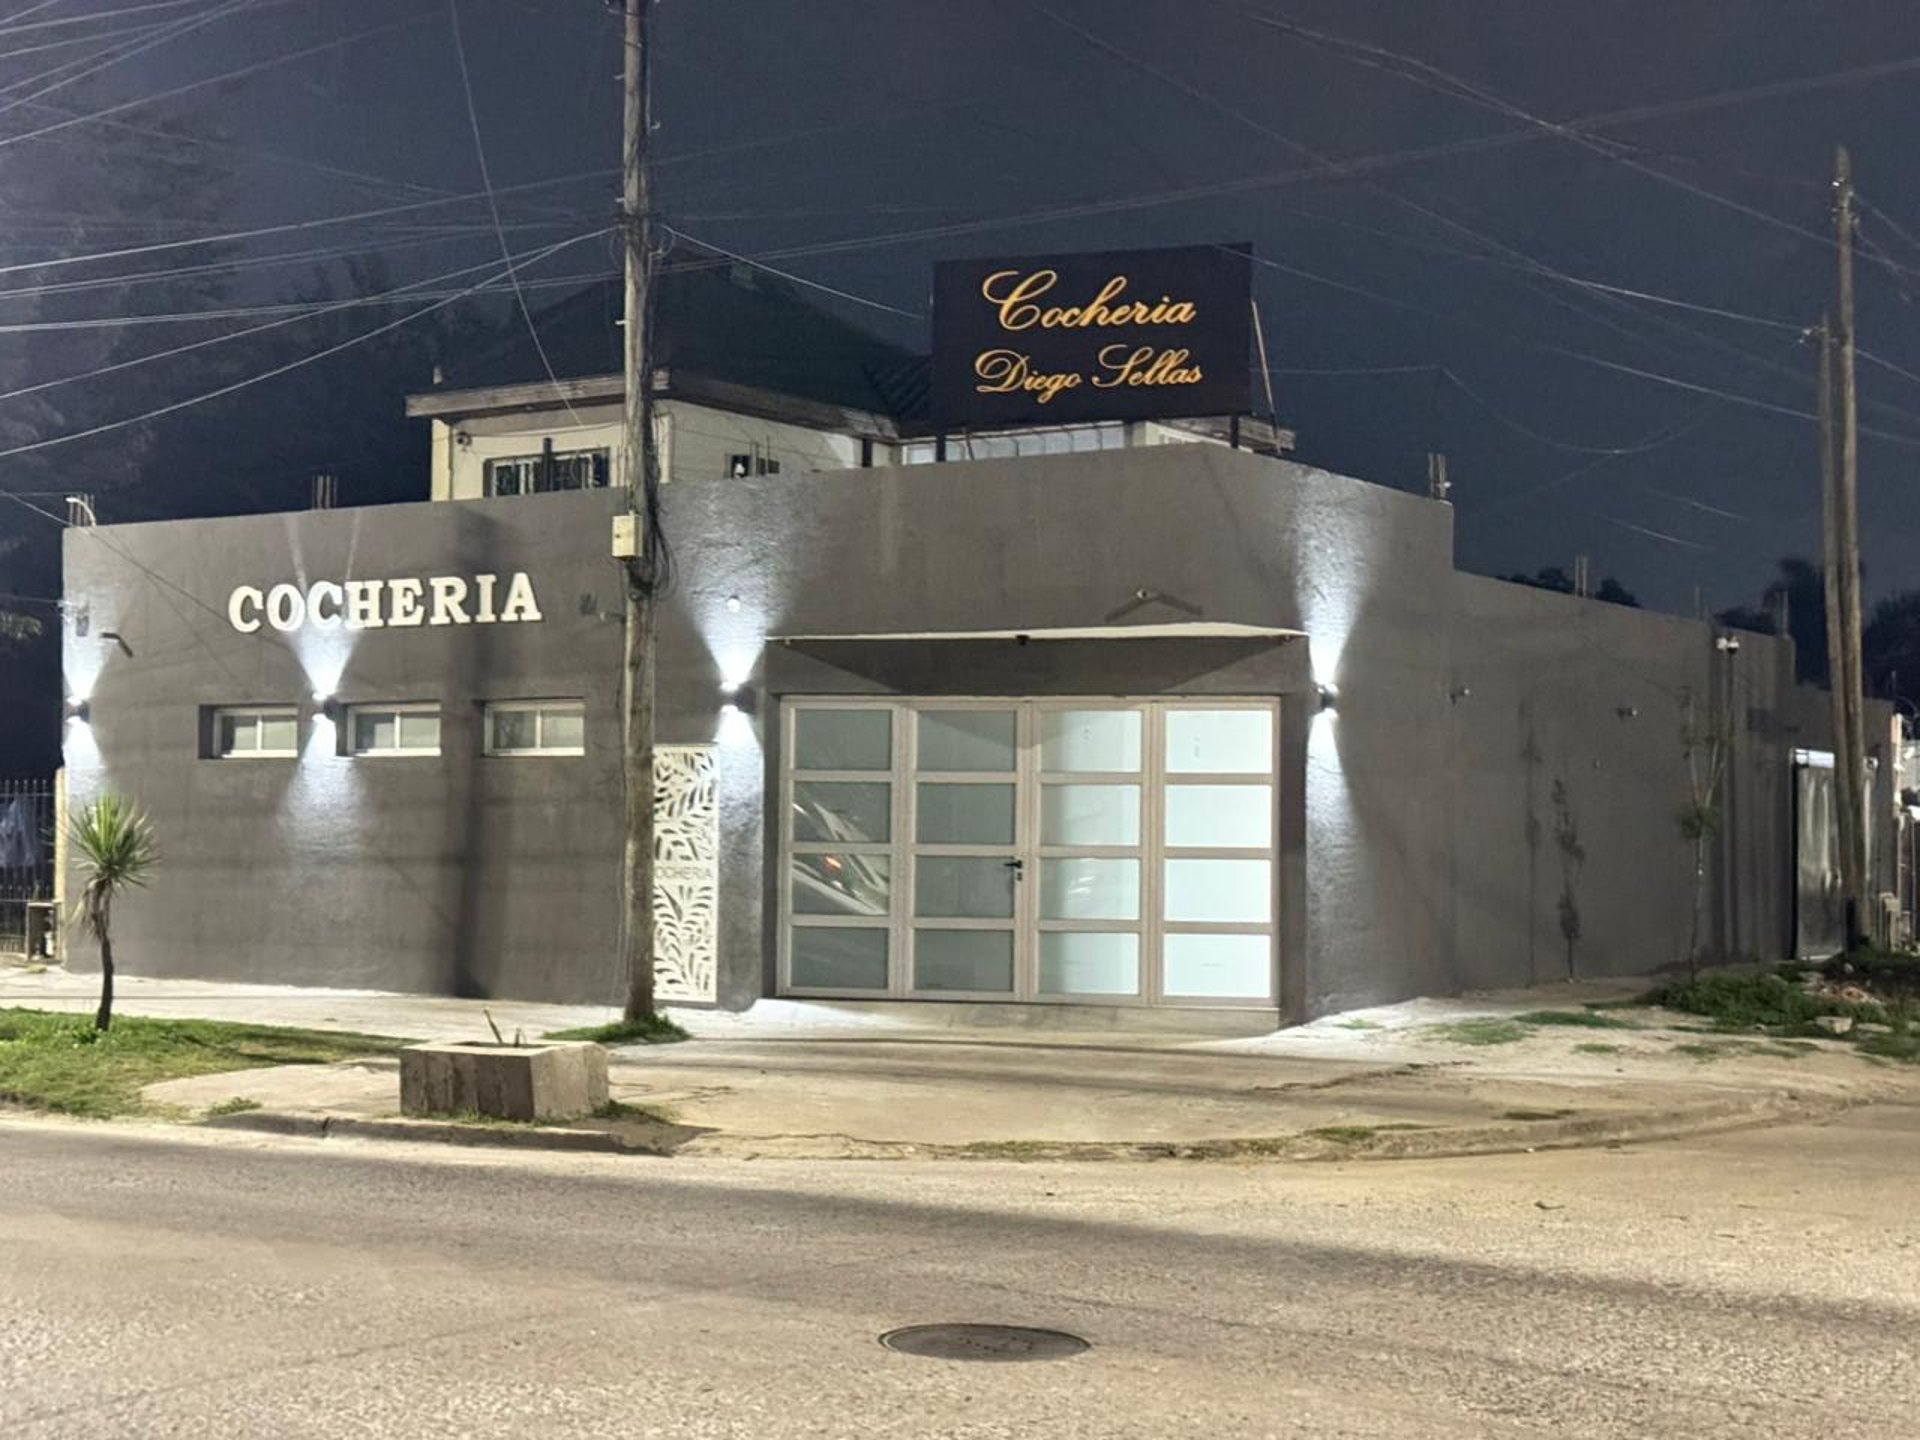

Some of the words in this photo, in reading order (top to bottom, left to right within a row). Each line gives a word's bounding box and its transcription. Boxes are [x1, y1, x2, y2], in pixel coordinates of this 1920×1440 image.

[982, 269, 1196, 331] Cocheria
[974, 349, 1082, 404] Diego
[1091, 344, 1203, 388] Sellas
[228, 571, 543, 633] COCHERIA
[653, 865, 714, 880] OCHERIA
